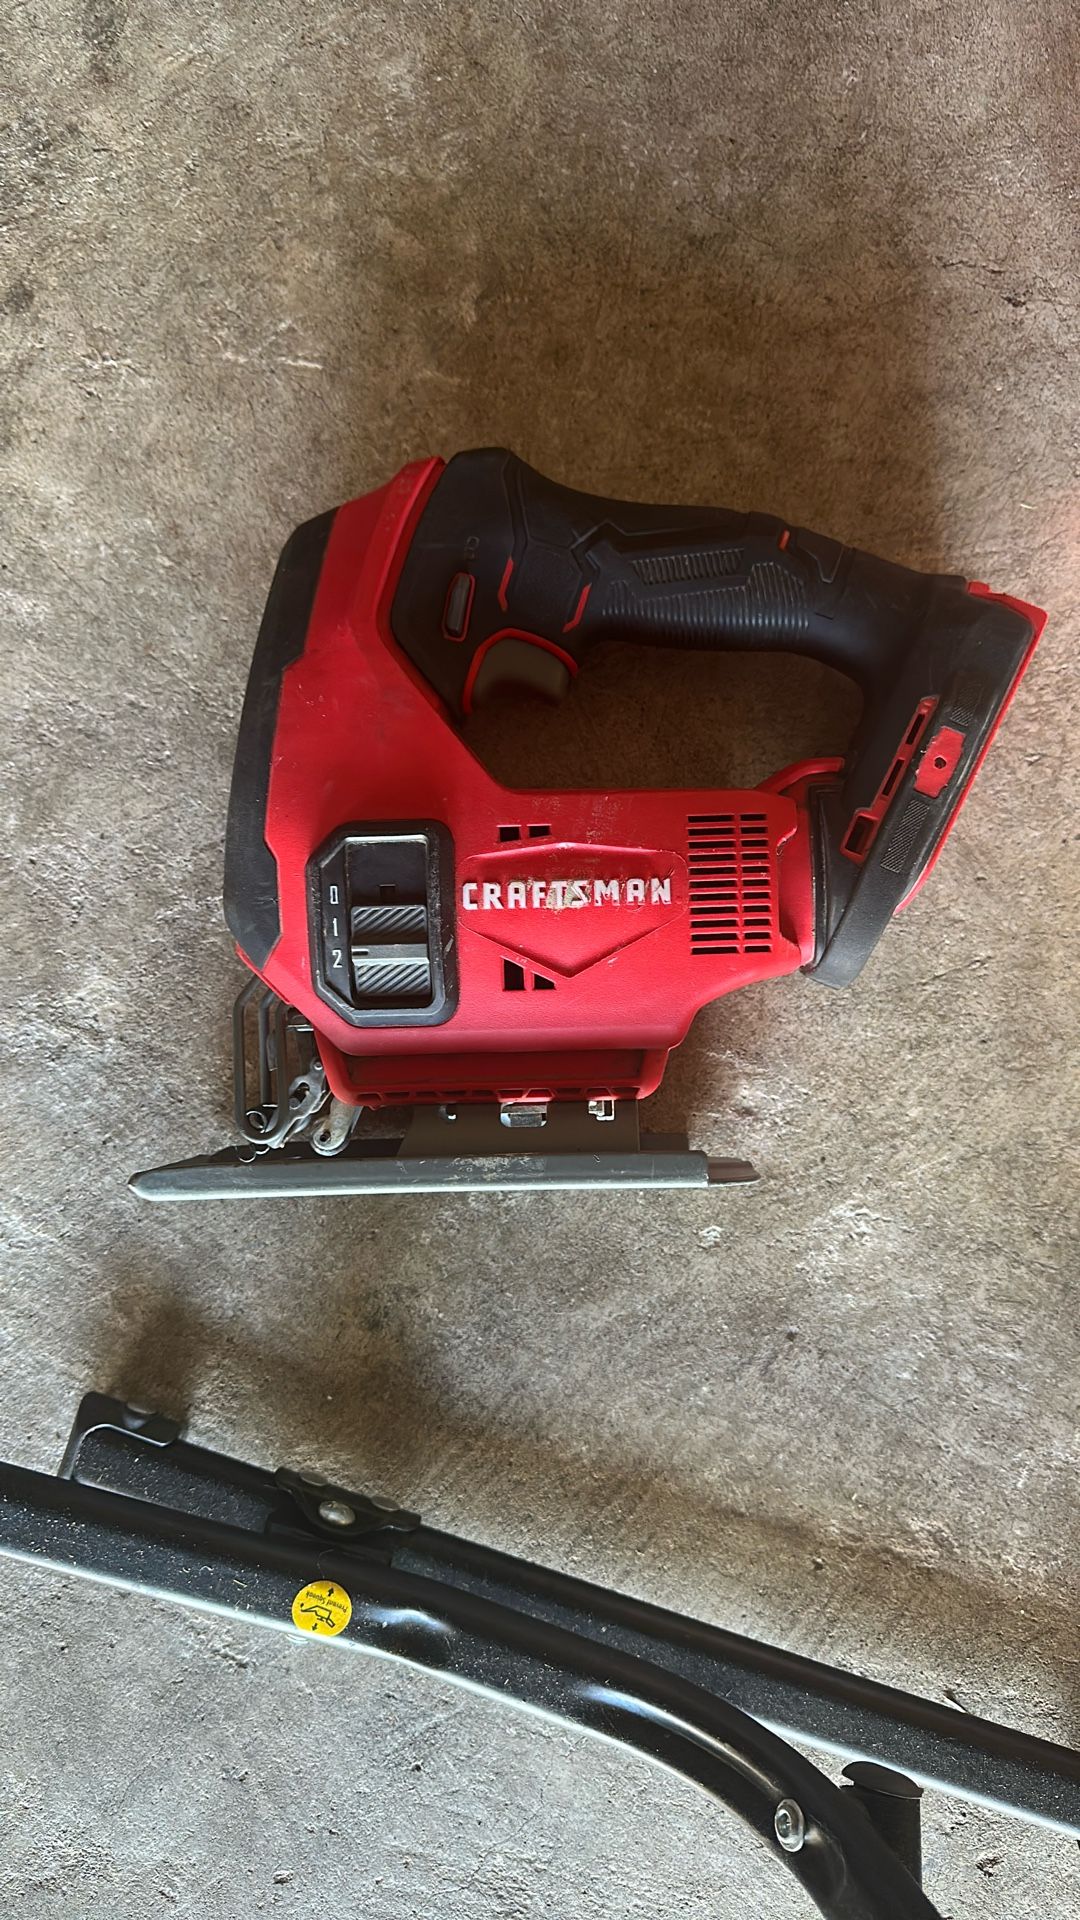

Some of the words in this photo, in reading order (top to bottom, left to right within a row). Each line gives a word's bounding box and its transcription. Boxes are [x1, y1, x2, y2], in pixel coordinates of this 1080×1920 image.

[462, 878, 672, 910] CRAFTSMAN
[332, 917, 339, 937] 1
[331, 949, 343, 969] 2
